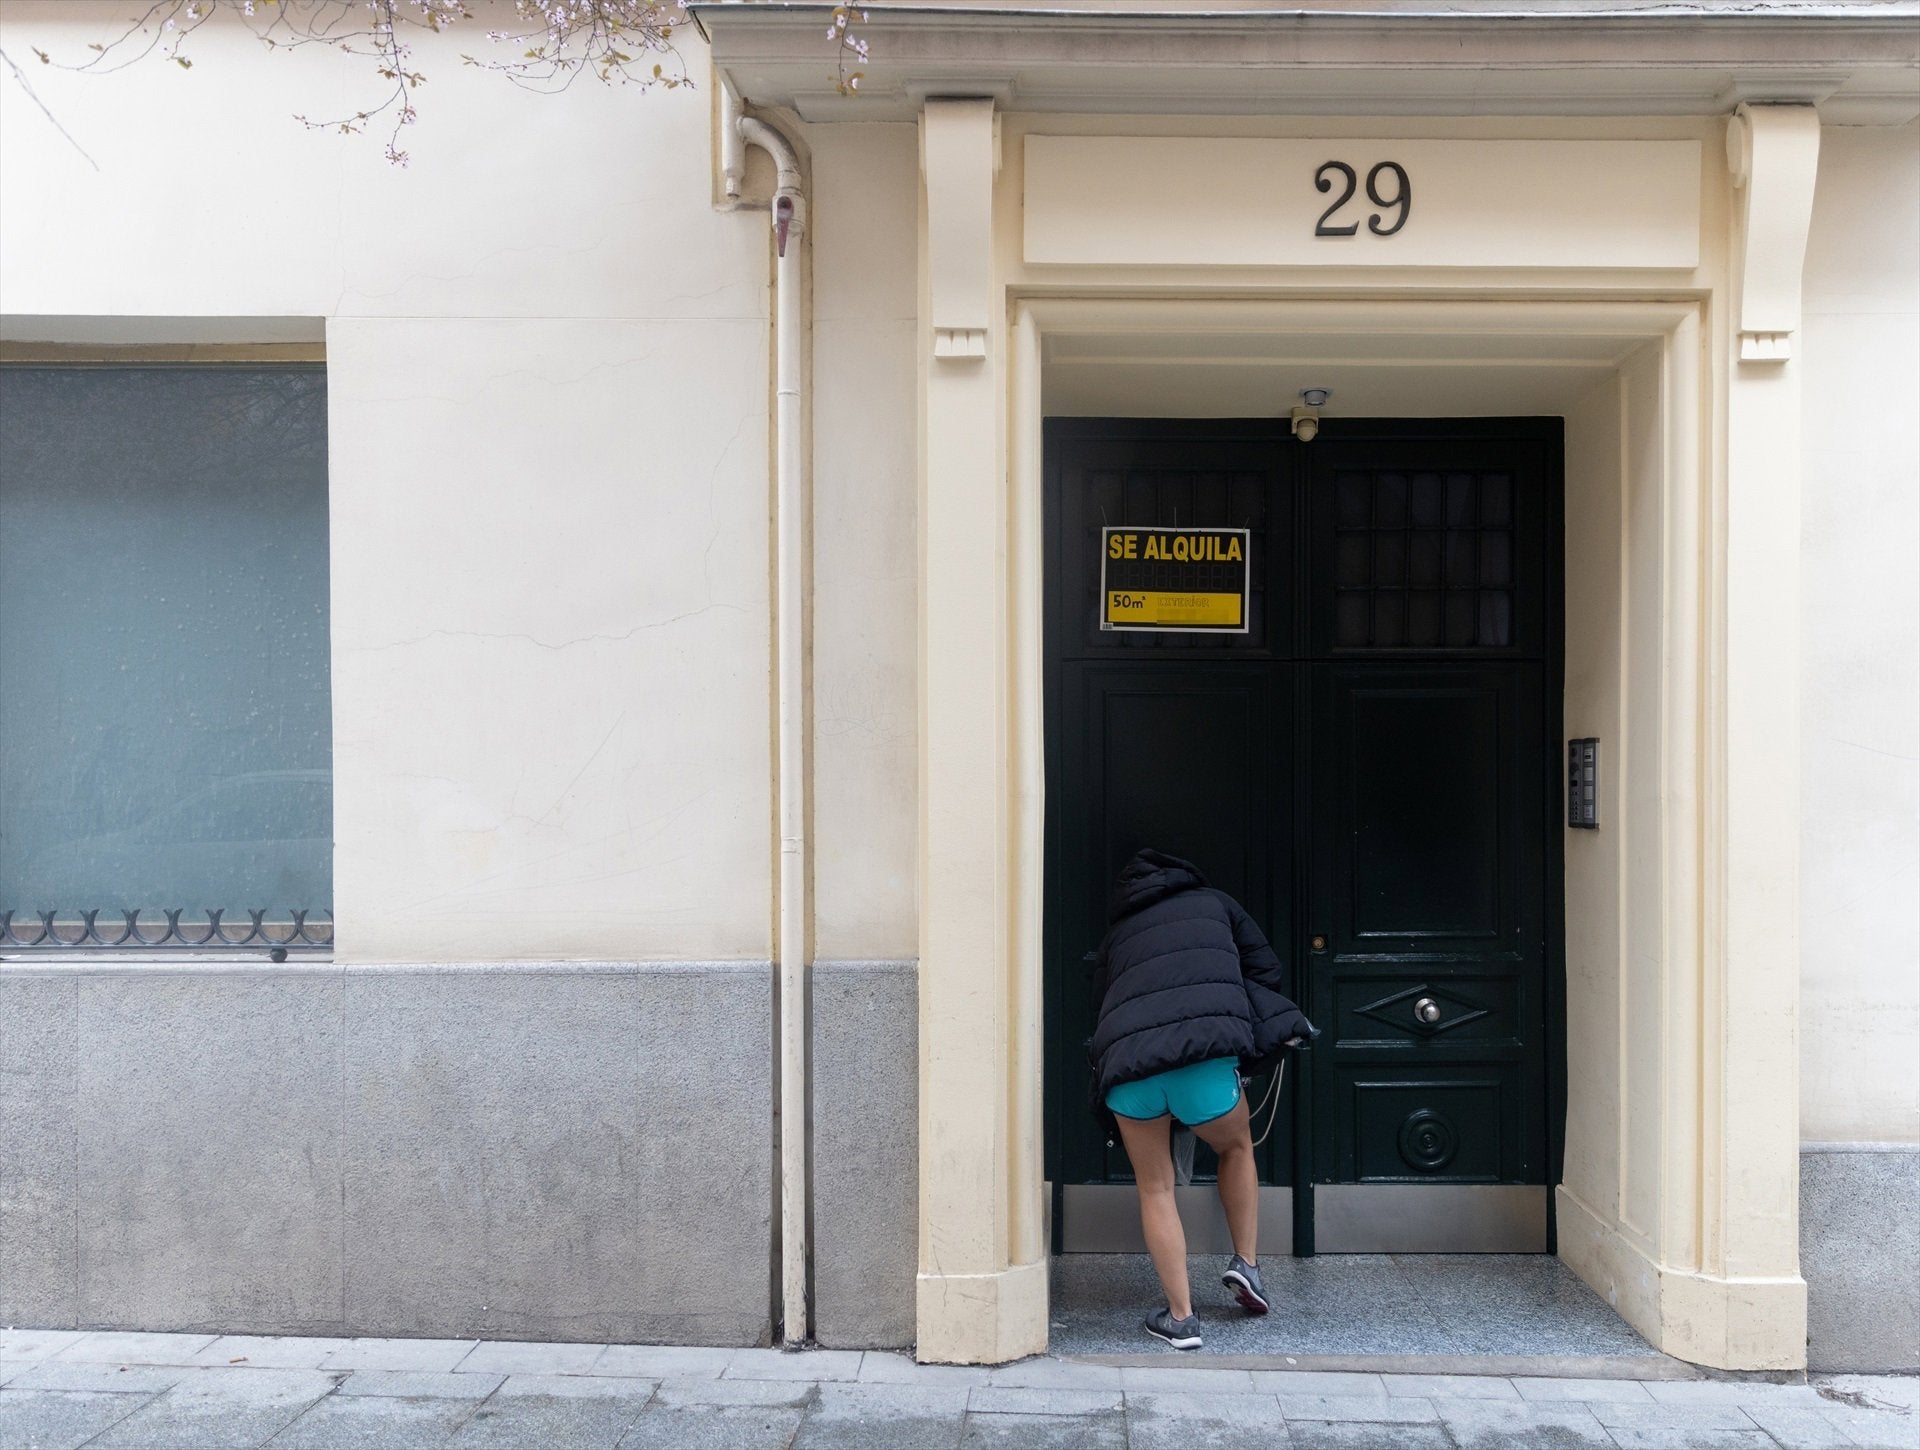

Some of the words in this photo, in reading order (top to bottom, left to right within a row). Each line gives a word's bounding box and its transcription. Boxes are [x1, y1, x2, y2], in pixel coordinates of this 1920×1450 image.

[1314, 160, 1411, 237] 29
[1109, 534, 1138, 559] SE
[1144, 535, 1242, 562] ALQUILA
